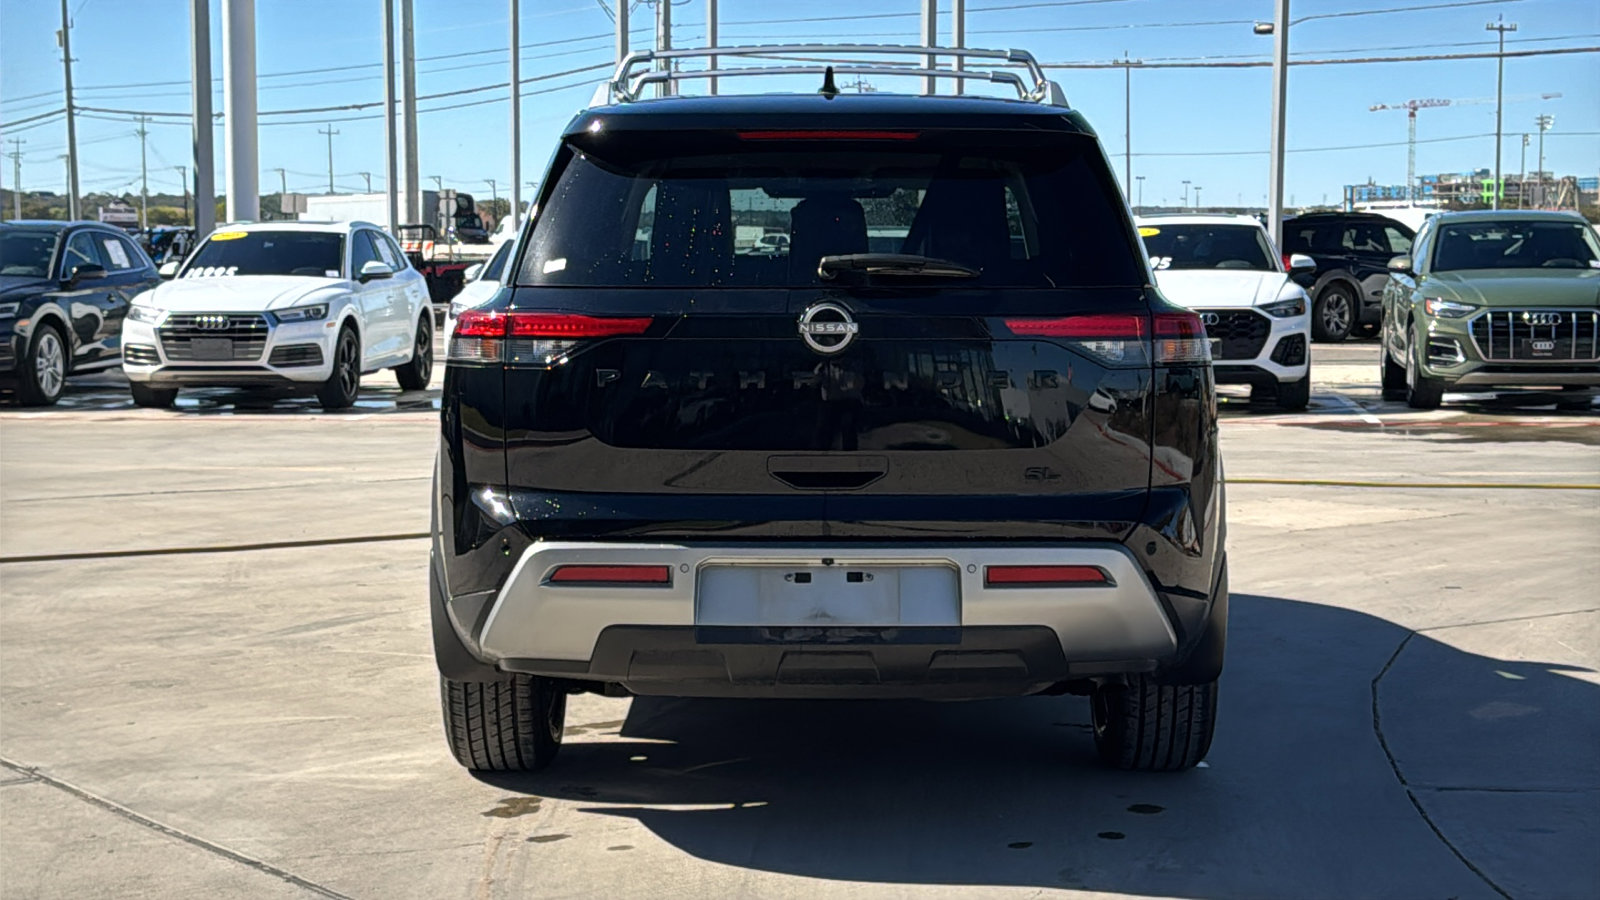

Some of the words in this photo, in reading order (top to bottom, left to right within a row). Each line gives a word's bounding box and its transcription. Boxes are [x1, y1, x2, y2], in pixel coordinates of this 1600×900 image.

[799, 323, 857, 333] NISSAN
[595, 368, 1059, 390] PATHFINDER
[1025, 466, 1062, 480] SL
